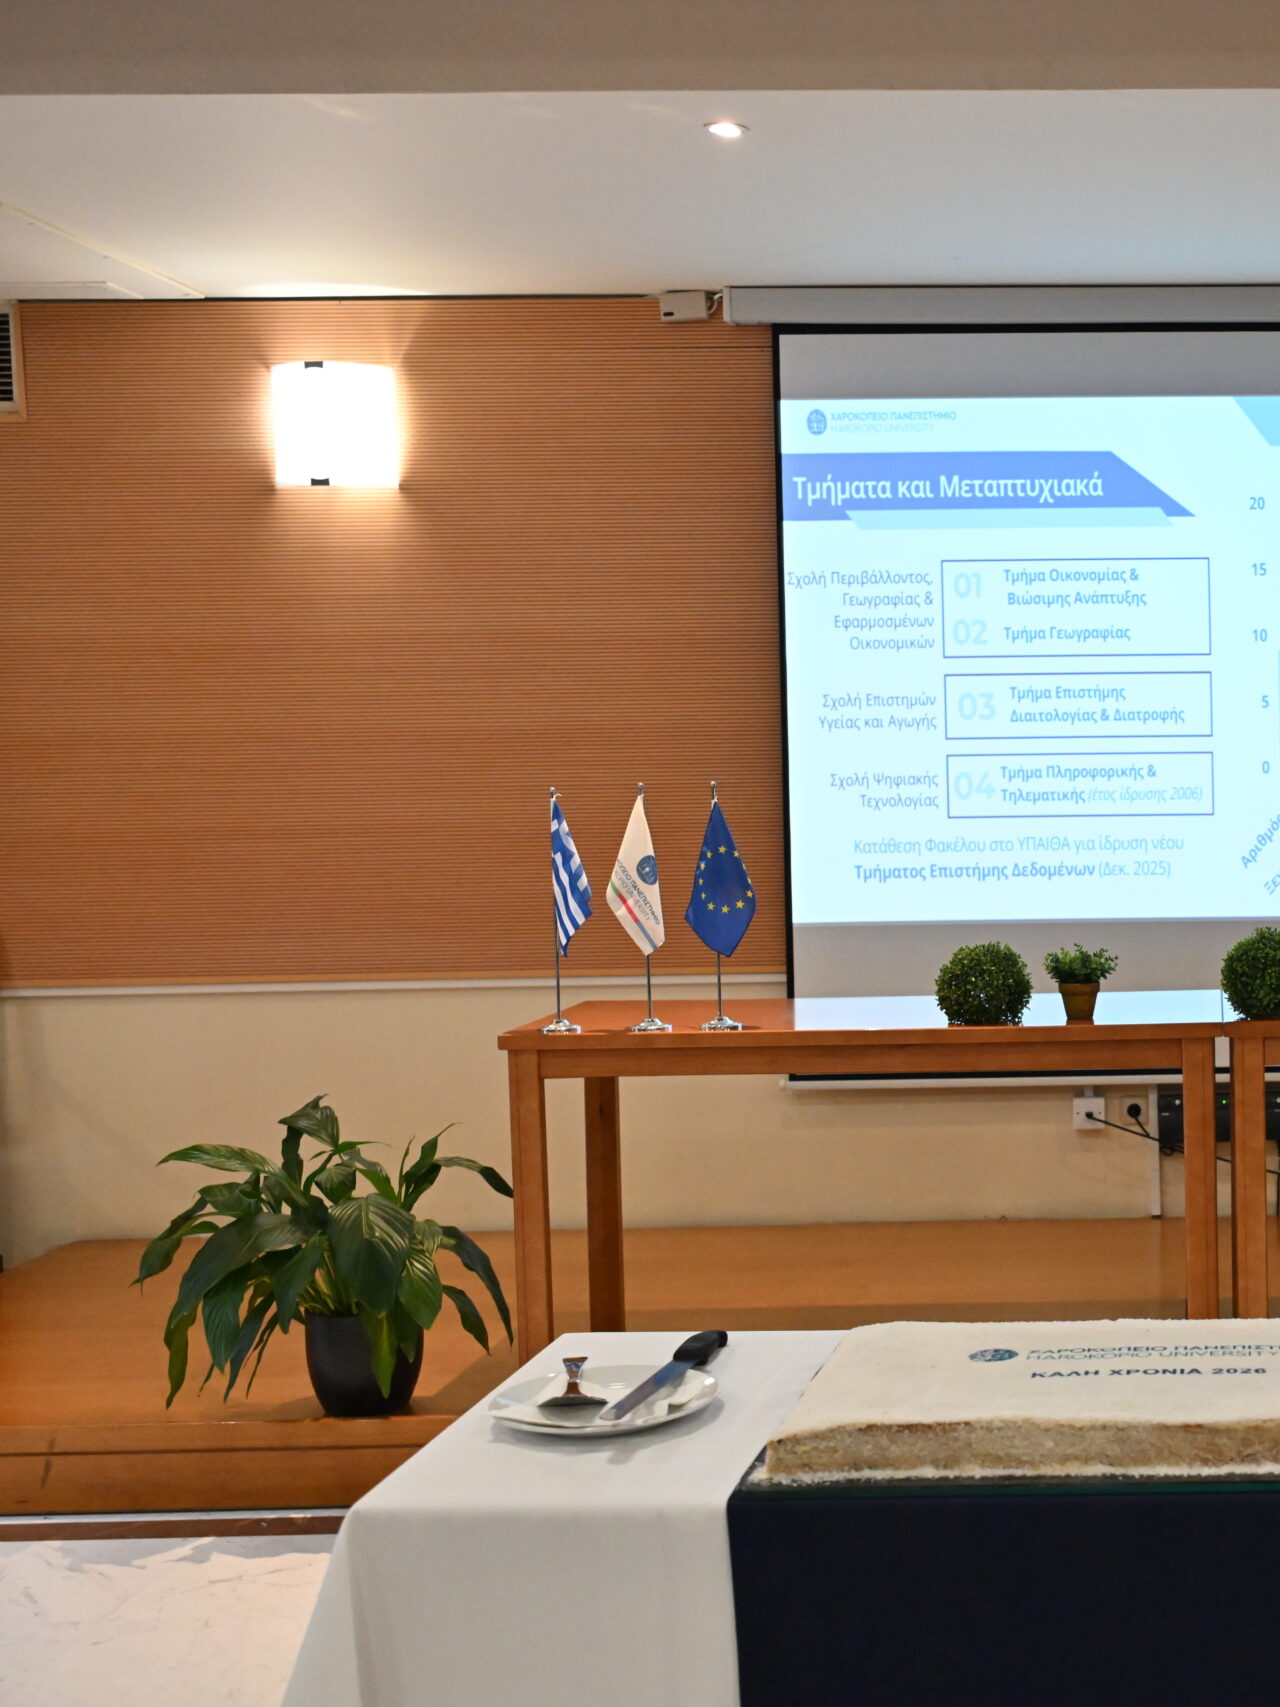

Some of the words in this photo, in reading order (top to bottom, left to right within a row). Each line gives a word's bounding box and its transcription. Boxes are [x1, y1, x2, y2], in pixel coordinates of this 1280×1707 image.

[792, 474, 890, 506] Τμήματα
[898, 478, 933, 499] και
[939, 471, 1103, 503] Μεταπτυχιακά
[1249, 497, 1265, 510] 20
[1003, 568, 1046, 585] Τμήμα
[1049, 567, 1127, 586] Οικονομίας
[1129, 568, 1139, 581] &
[1252, 563, 1267, 576] 15
[787, 570, 827, 589] Σχολή
[830, 570, 934, 587] Περιβάλλοντος,
[953, 572, 982, 599] 01
[842, 592, 921, 609] Γεωγραφίας
[924, 592, 933, 605] &
[1008, 591, 1071, 607] Βιώσιμης
[1074, 591, 1147, 608] Ανάπτυξης
[834, 614, 934, 631] Εφαρμοσμένων
[953, 619, 988, 645] 02
[1003, 626, 1046, 643] Τμήμα
[1049, 625, 1131, 643] Γεωγραφίας
[1252, 629, 1267, 642] 10
[850, 636, 935, 653] Οικονομικών
[822, 694, 862, 710] Σχολή
[865, 692, 936, 708] Επιστημών
[1010, 686, 1053, 702] Τμήμα
[1055, 685, 1126, 702] Επιστήμης
[1262, 695, 1269, 708] 5
[957, 692, 996, 721] 03
[818, 716, 861, 731] Υγείας
[864, 717, 885, 729] και
[888, 715, 937, 731] Αγωγής
[1010, 708, 1097, 725] Διαιτολογίας
[1100, 708, 1110, 722] &
[1113, 707, 1185, 725] Διατροφής
[1001, 766, 1043, 782] Τμήμα
[1046, 764, 1144, 781] Πληροφορικής
[1146, 765, 1157, 778] &
[1262, 761, 1270, 774] 0
[830, 773, 870, 789] Σχολή
[873, 771, 939, 788] Ψηφιακής
[954, 771, 996, 801] 04
[860, 794, 939, 811] Τεχνολογίας
[1001, 787, 1085, 805] Τηλεματικής
[1169, 786, 1203, 802] 2006)
[854, 838, 921, 855] Κατάθεση
[925, 837, 986, 855] Φακέλου
[989, 839, 1014, 852] στο
[1017, 836, 1071, 852] ΥΠΑΙΘΑ
[1074, 837, 1095, 855] για
[1098, 835, 1148, 852] ίδρυση
[1151, 835, 1184, 851] νέου
[854, 863, 927, 883] Τμήματος
[930, 863, 1008, 882] Επιστήμης
[1011, 862, 1095, 879] Δεδομένων
[1098, 861, 1131, 879] (Δεκ.
[1134, 860, 1172, 877] 2025)
[1030, 1370, 1100, 1378] ΚΑΛΗ
[1109, 1368, 1201, 1376] ΧΡΟΝΙΑ
[1211, 1367, 1267, 1375] 2026
